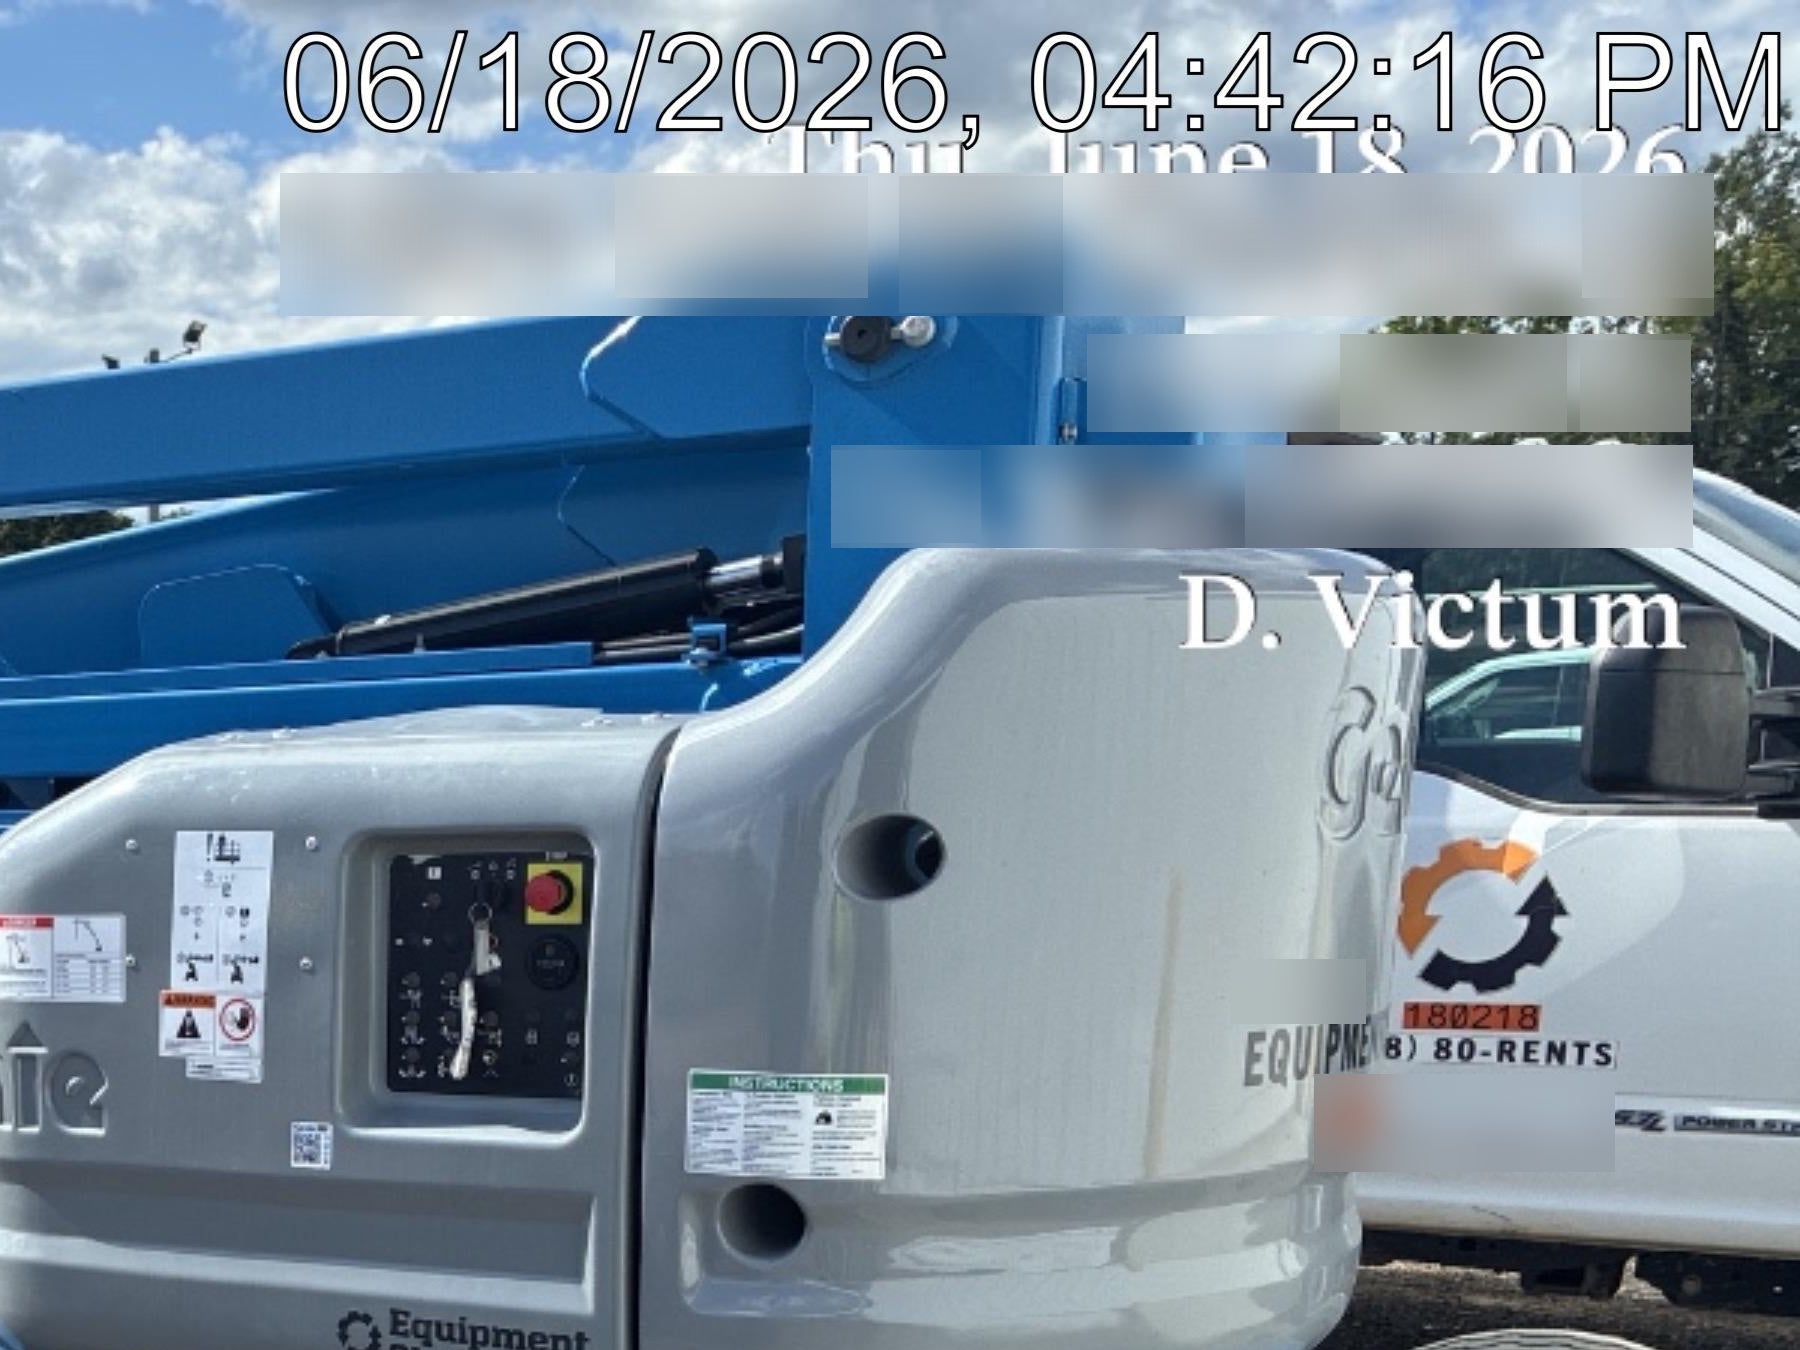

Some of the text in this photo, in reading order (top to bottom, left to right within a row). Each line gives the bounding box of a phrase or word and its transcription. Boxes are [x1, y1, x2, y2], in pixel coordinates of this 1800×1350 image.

[1406, 1003, 1539, 1030] 180218
[1433, 1037, 1613, 1067] 80-RENTS
[728, 1076, 845, 1092] INSTRUCTIONS
